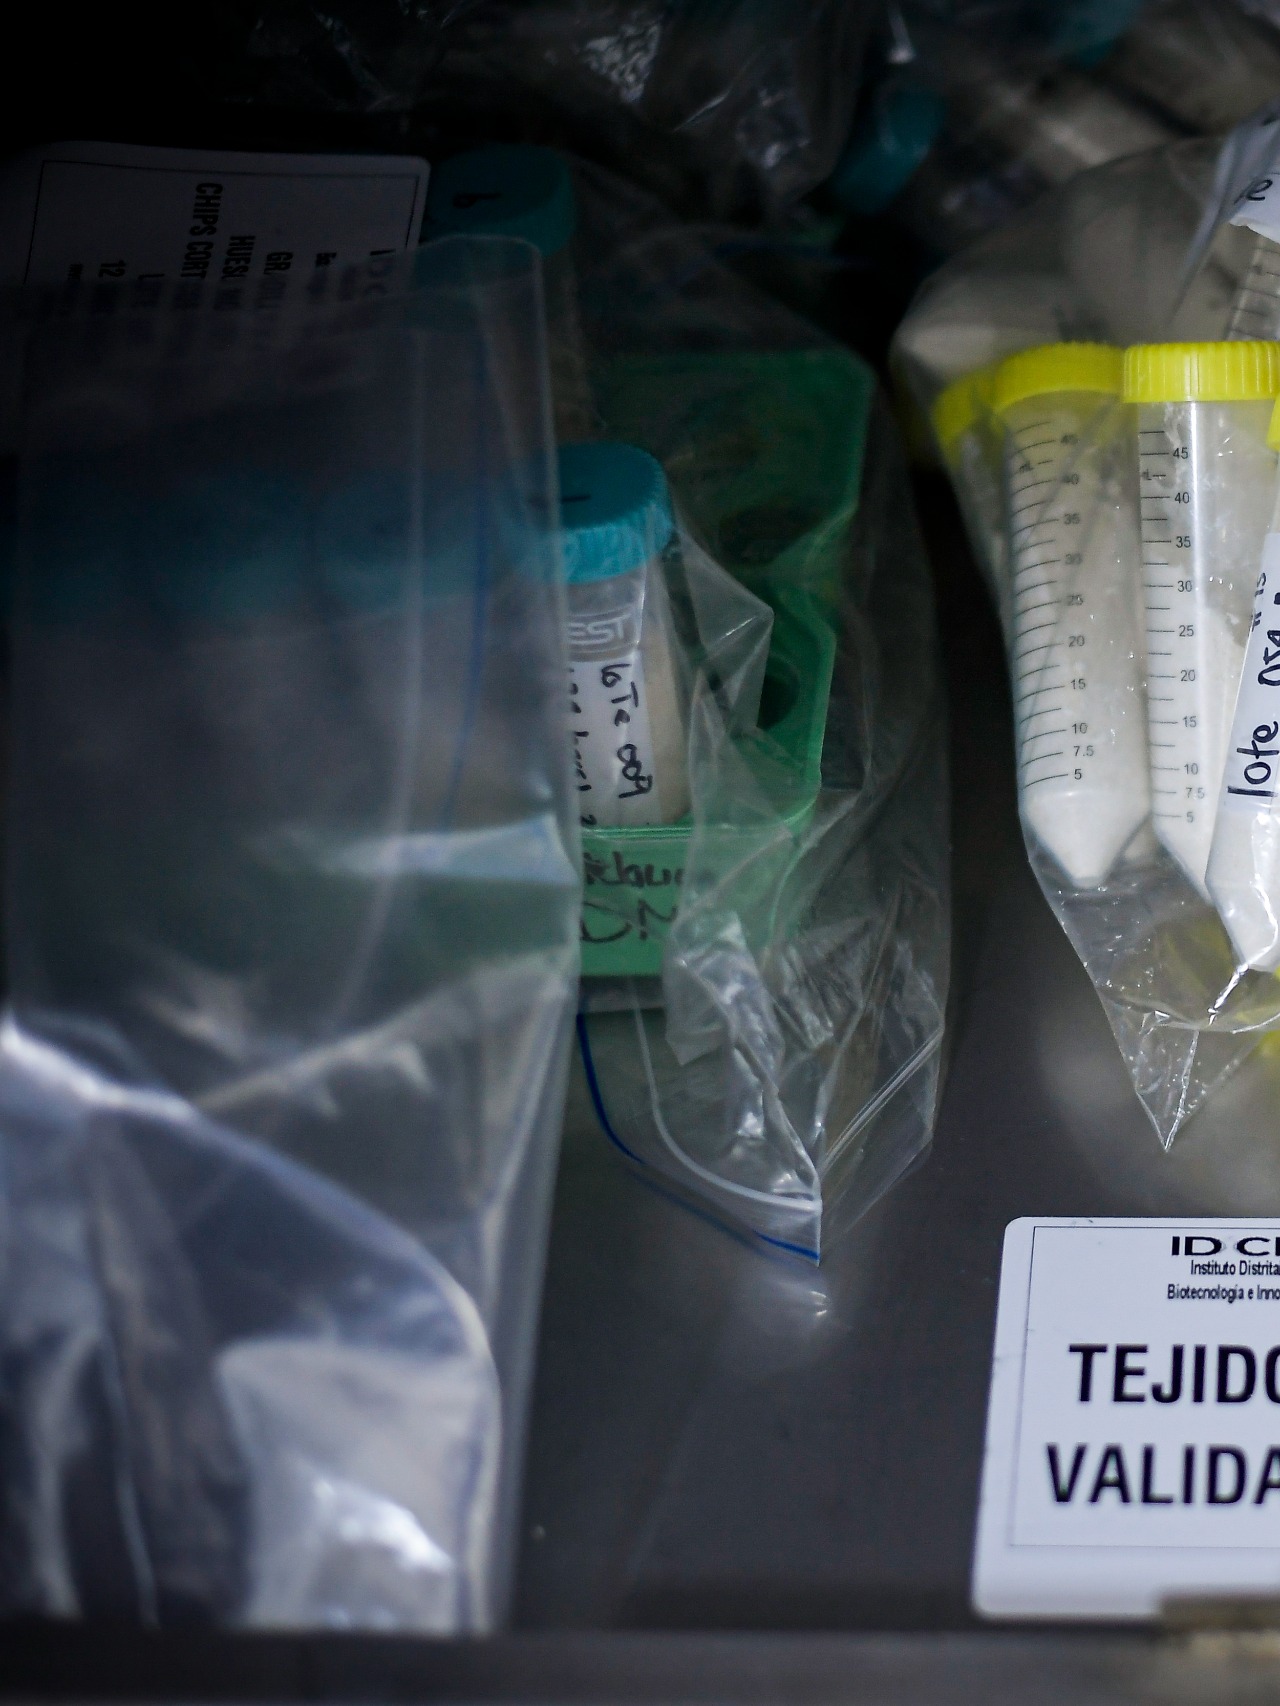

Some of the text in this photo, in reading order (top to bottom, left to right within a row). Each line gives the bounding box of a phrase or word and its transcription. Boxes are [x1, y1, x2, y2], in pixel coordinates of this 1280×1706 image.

[189, 182, 223, 237] CHIPS
[1172, 447, 1190, 460] 45
[1174, 491, 1191, 504] 40
[1175, 535, 1192, 549] 35
[1177, 579, 1193, 593] 30
[1178, 624, 1195, 637] 25
[1068, 635, 1086, 648] 20
[1180, 669, 1196, 682] 20
[1070, 678, 1087, 690] 15
[1182, 715, 1197, 728] 15
[1071, 722, 1089, 735] 10
[1073, 745, 1095, 757] 7.5
[1227, 720, 1280, 799] lote
[1073, 768, 1083, 781] 5
[1184, 762, 1199, 775] 10
[1185, 787, 1205, 800] 7.5
[1186, 811, 1194, 824] 5
[1190, 1259, 1236, 1276] Instituto
[1247, 1288, 1254, 1300] e
